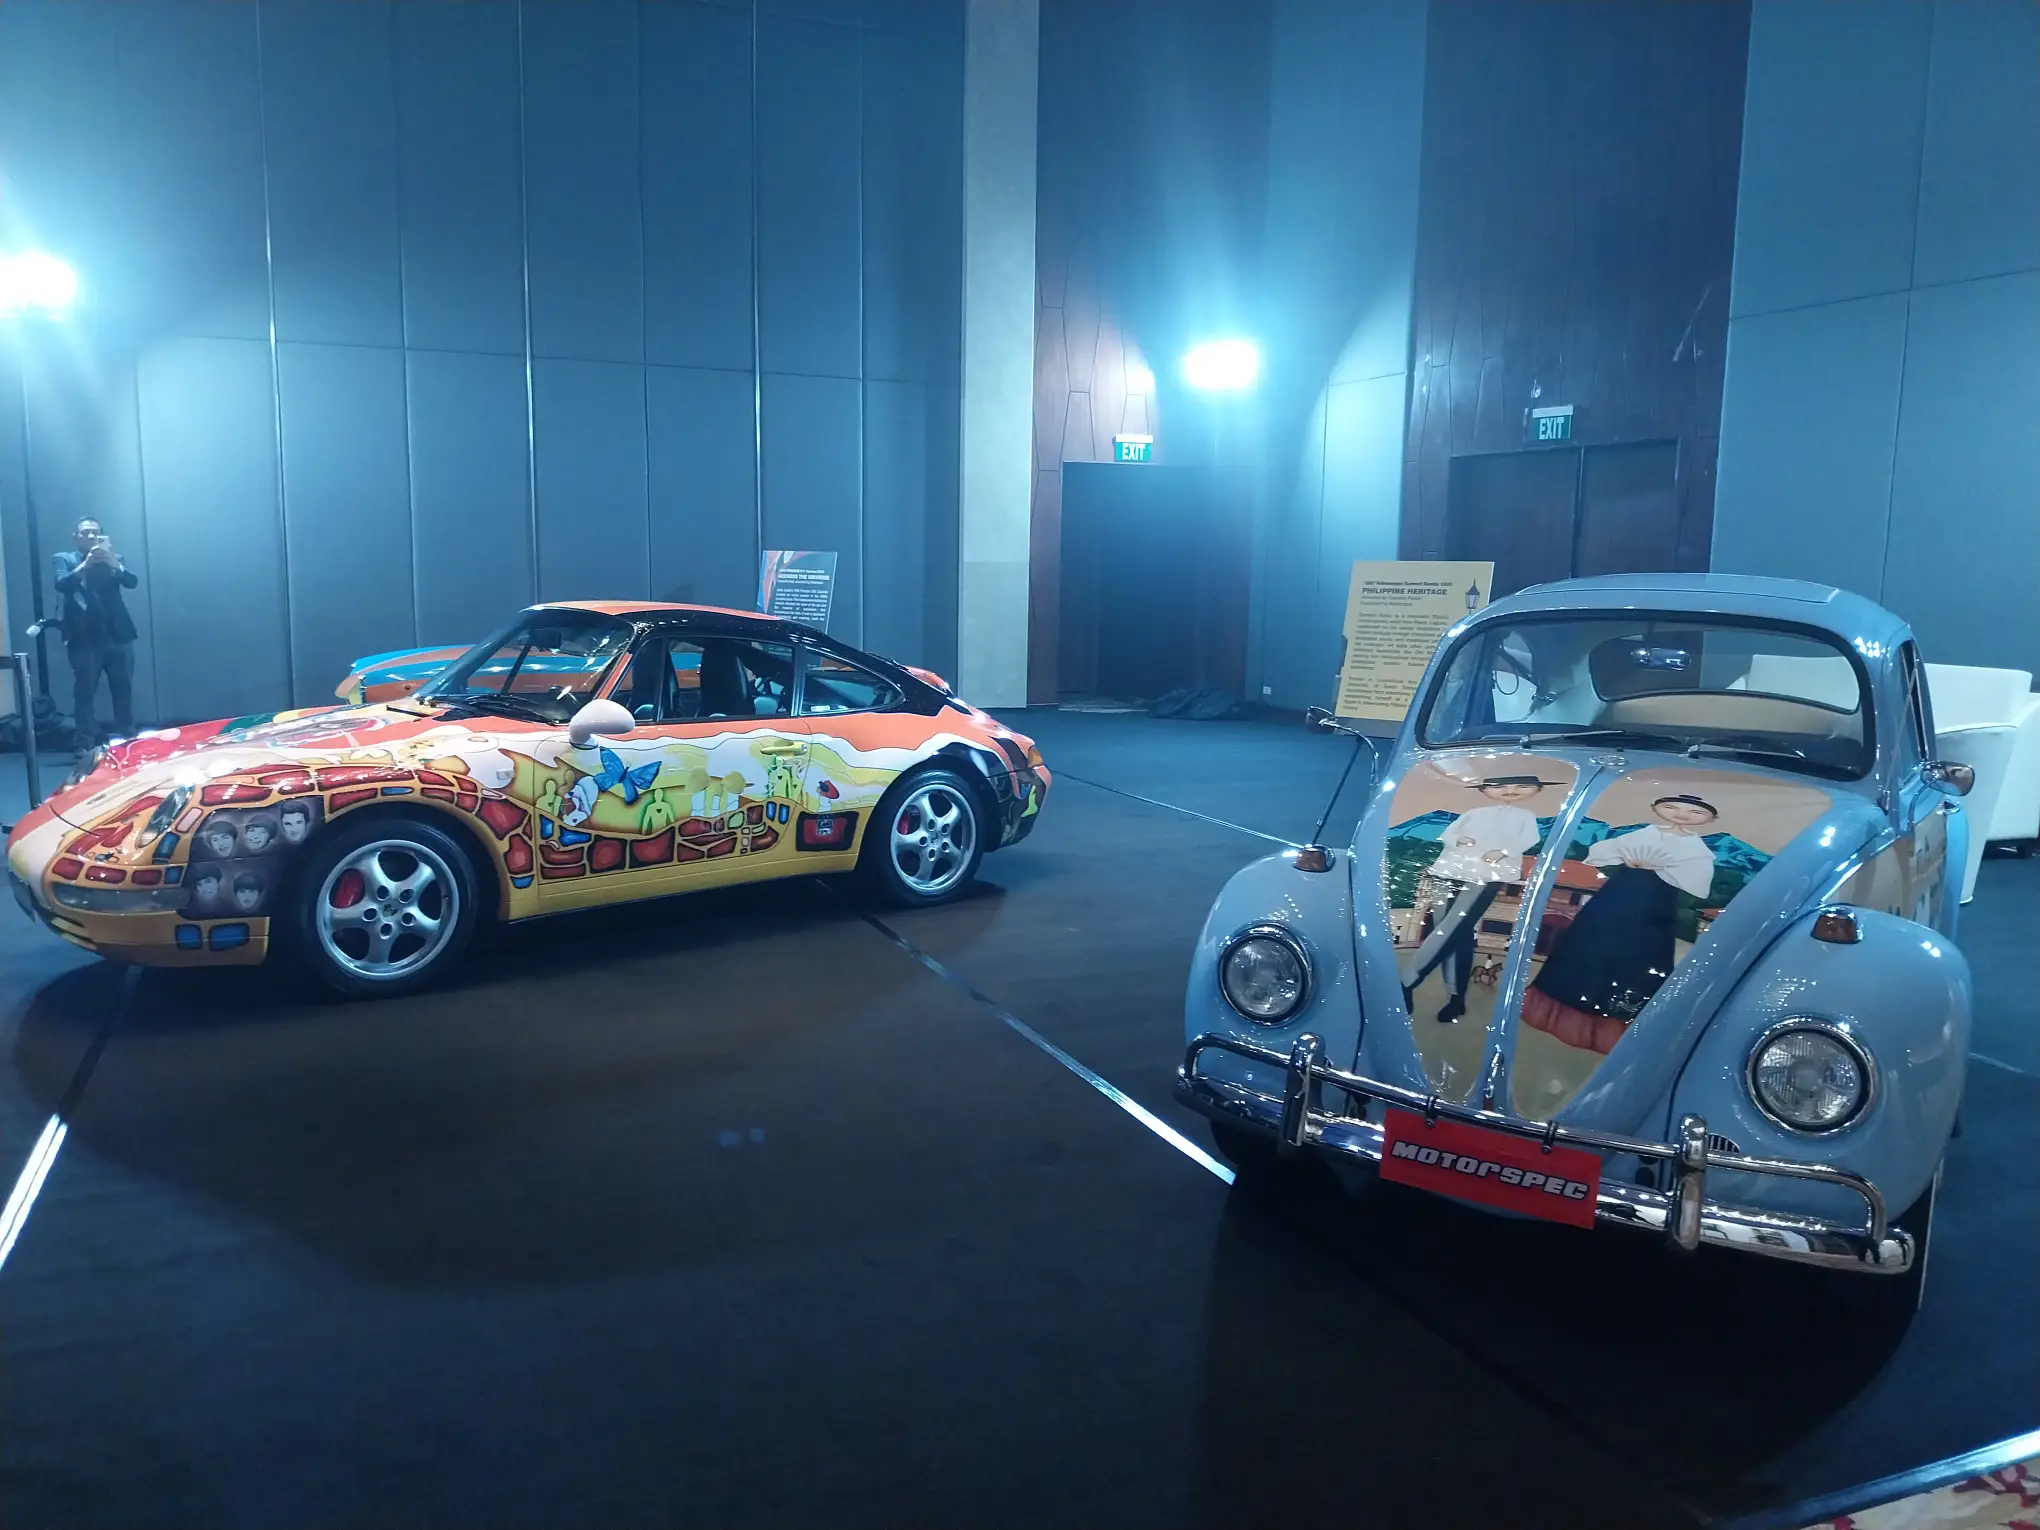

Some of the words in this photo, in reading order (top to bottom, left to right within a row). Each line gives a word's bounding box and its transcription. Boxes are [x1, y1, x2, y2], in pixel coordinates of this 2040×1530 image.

[1539, 417, 1564, 439] EXIT
[1122, 443, 1146, 460] EXIT
[1362, 587, 1405, 595] PHILIPPINE
[1407, 588, 1448, 596] HERITAGE
